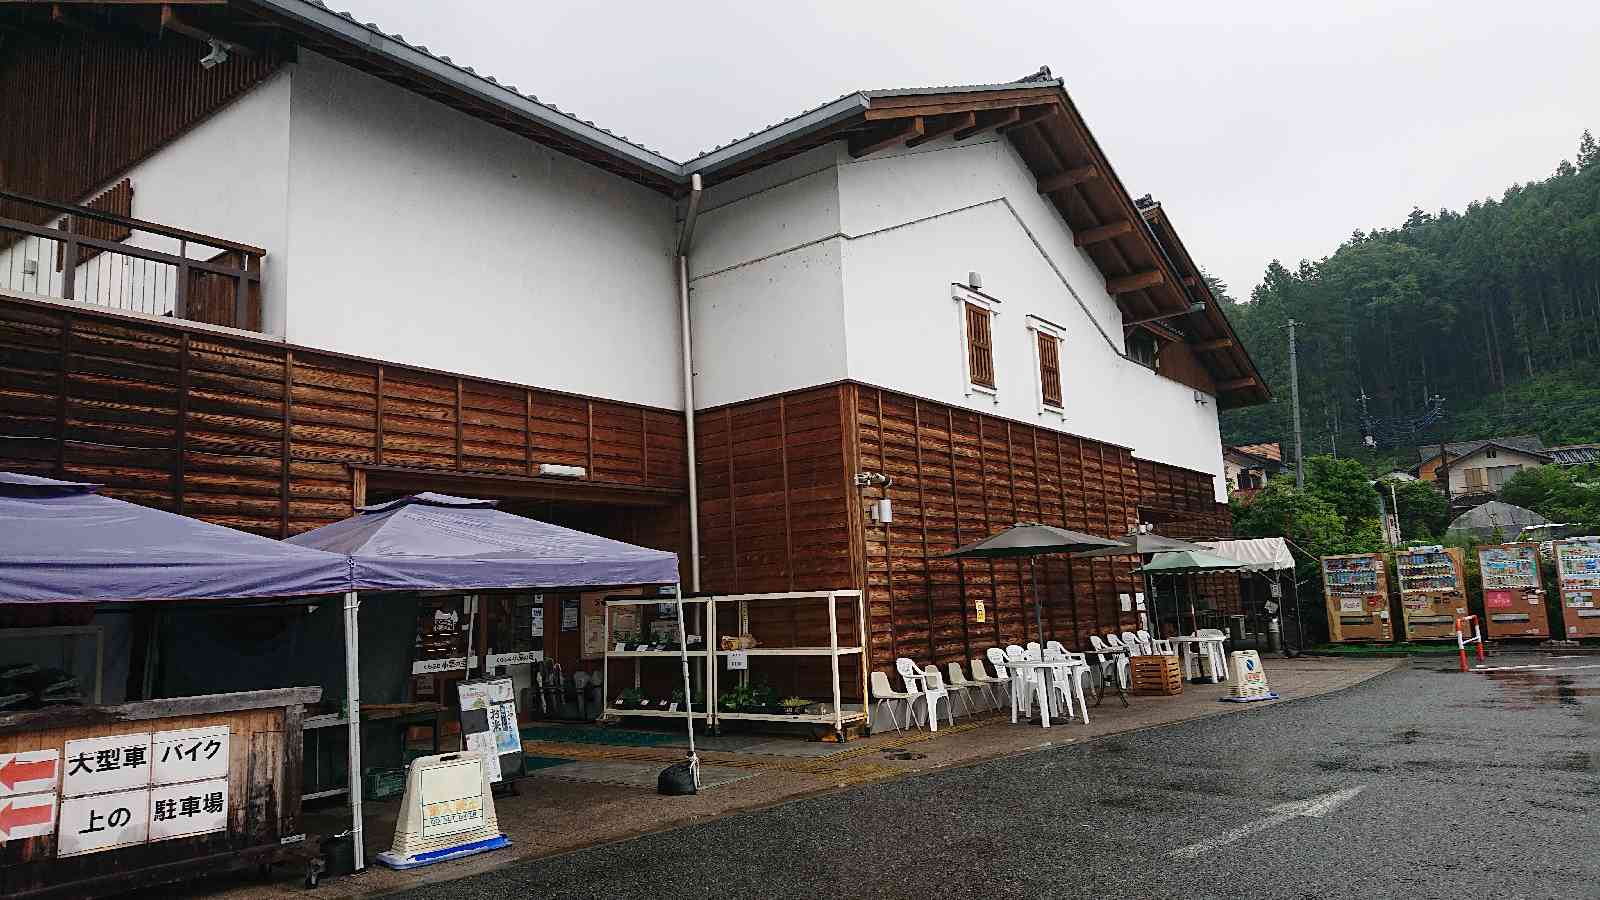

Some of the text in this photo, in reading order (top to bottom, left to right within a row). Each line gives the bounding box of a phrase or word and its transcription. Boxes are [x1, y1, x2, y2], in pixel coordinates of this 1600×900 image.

[69, 747, 147, 776] 大型車
[162, 740, 222, 762] バイク
[154, 792, 224, 821] 駐車場
[79, 808, 131, 834] 上の
